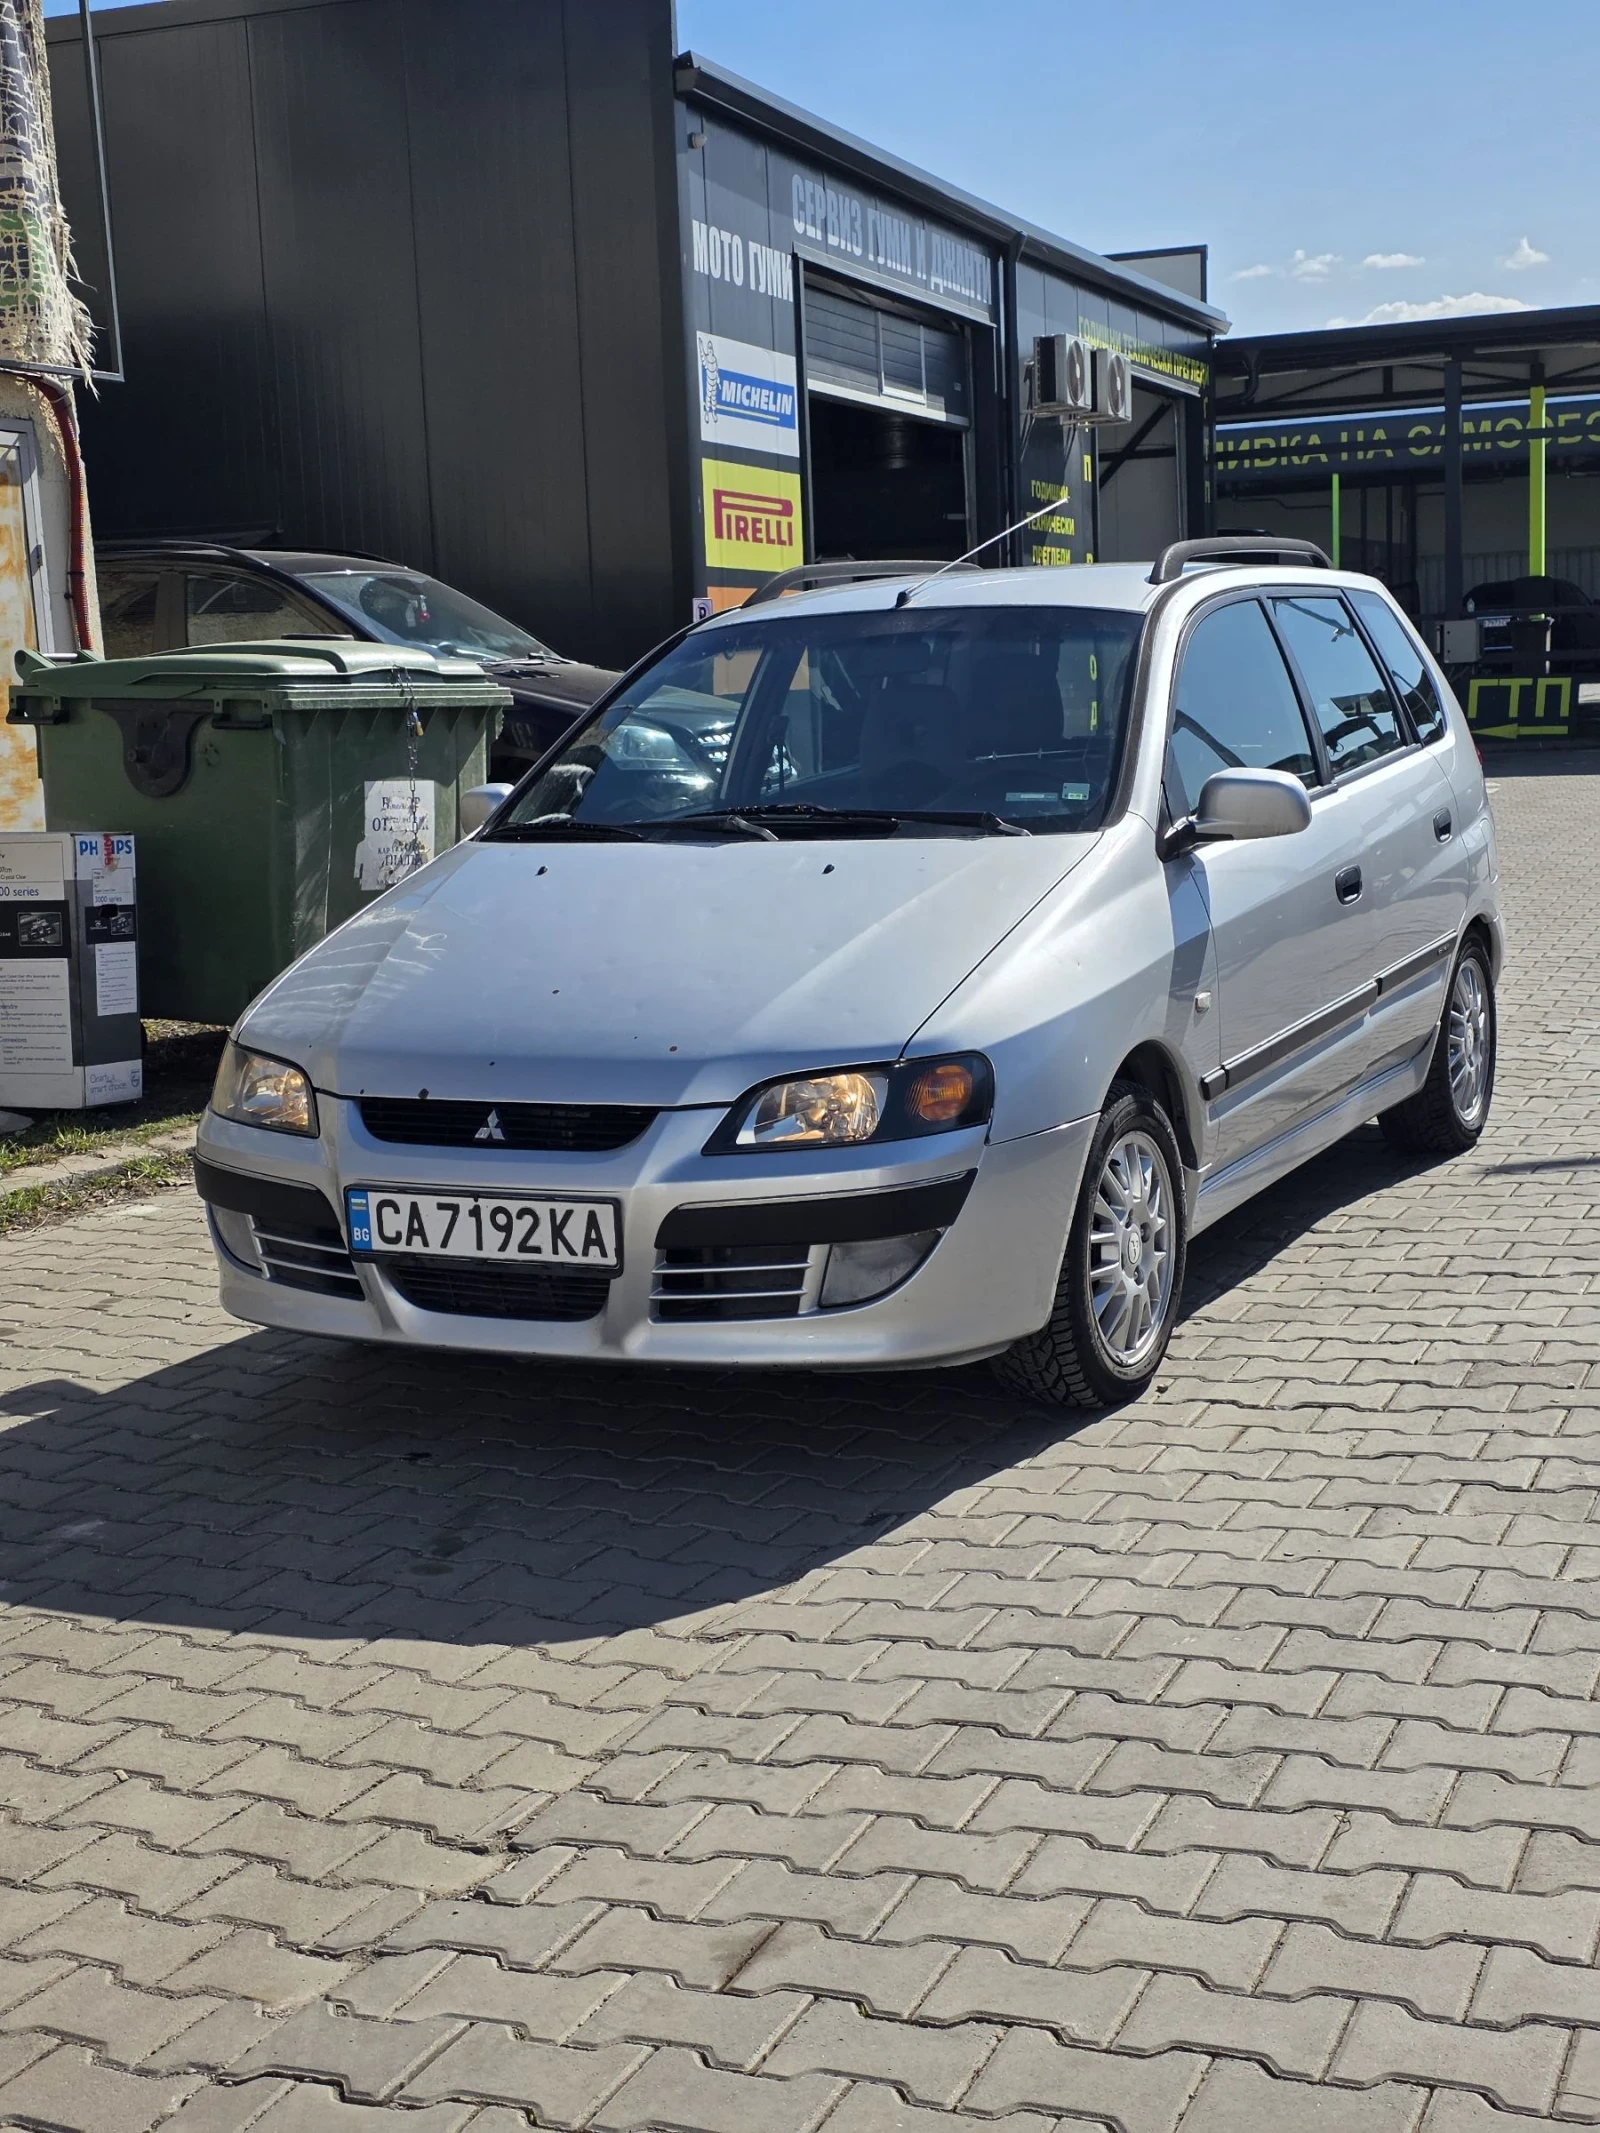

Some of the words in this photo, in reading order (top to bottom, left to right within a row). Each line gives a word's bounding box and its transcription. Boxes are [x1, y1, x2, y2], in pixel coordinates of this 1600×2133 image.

[692, 219, 743, 286] МОТО
[748, 240, 793, 301] ГУМИ
[791, 174, 862, 256] СЕРВИЗ
[867, 207, 912, 275] ГУМИ
[915, 228, 927, 279] И
[930, 232, 992, 305] ДЖАНТИ
[721, 379, 792, 416] MICHELIN
[1216, 434, 1328, 470] ИВКА
[1340, 429, 1394, 461] НА
[713, 489, 793, 547] PIRELLI
[1467, 677, 1572, 719] ГТП
[79, 840, 132, 855] PHIPS
[13, 887, 39, 897] series
[354, 1227, 370, 1242] BG
